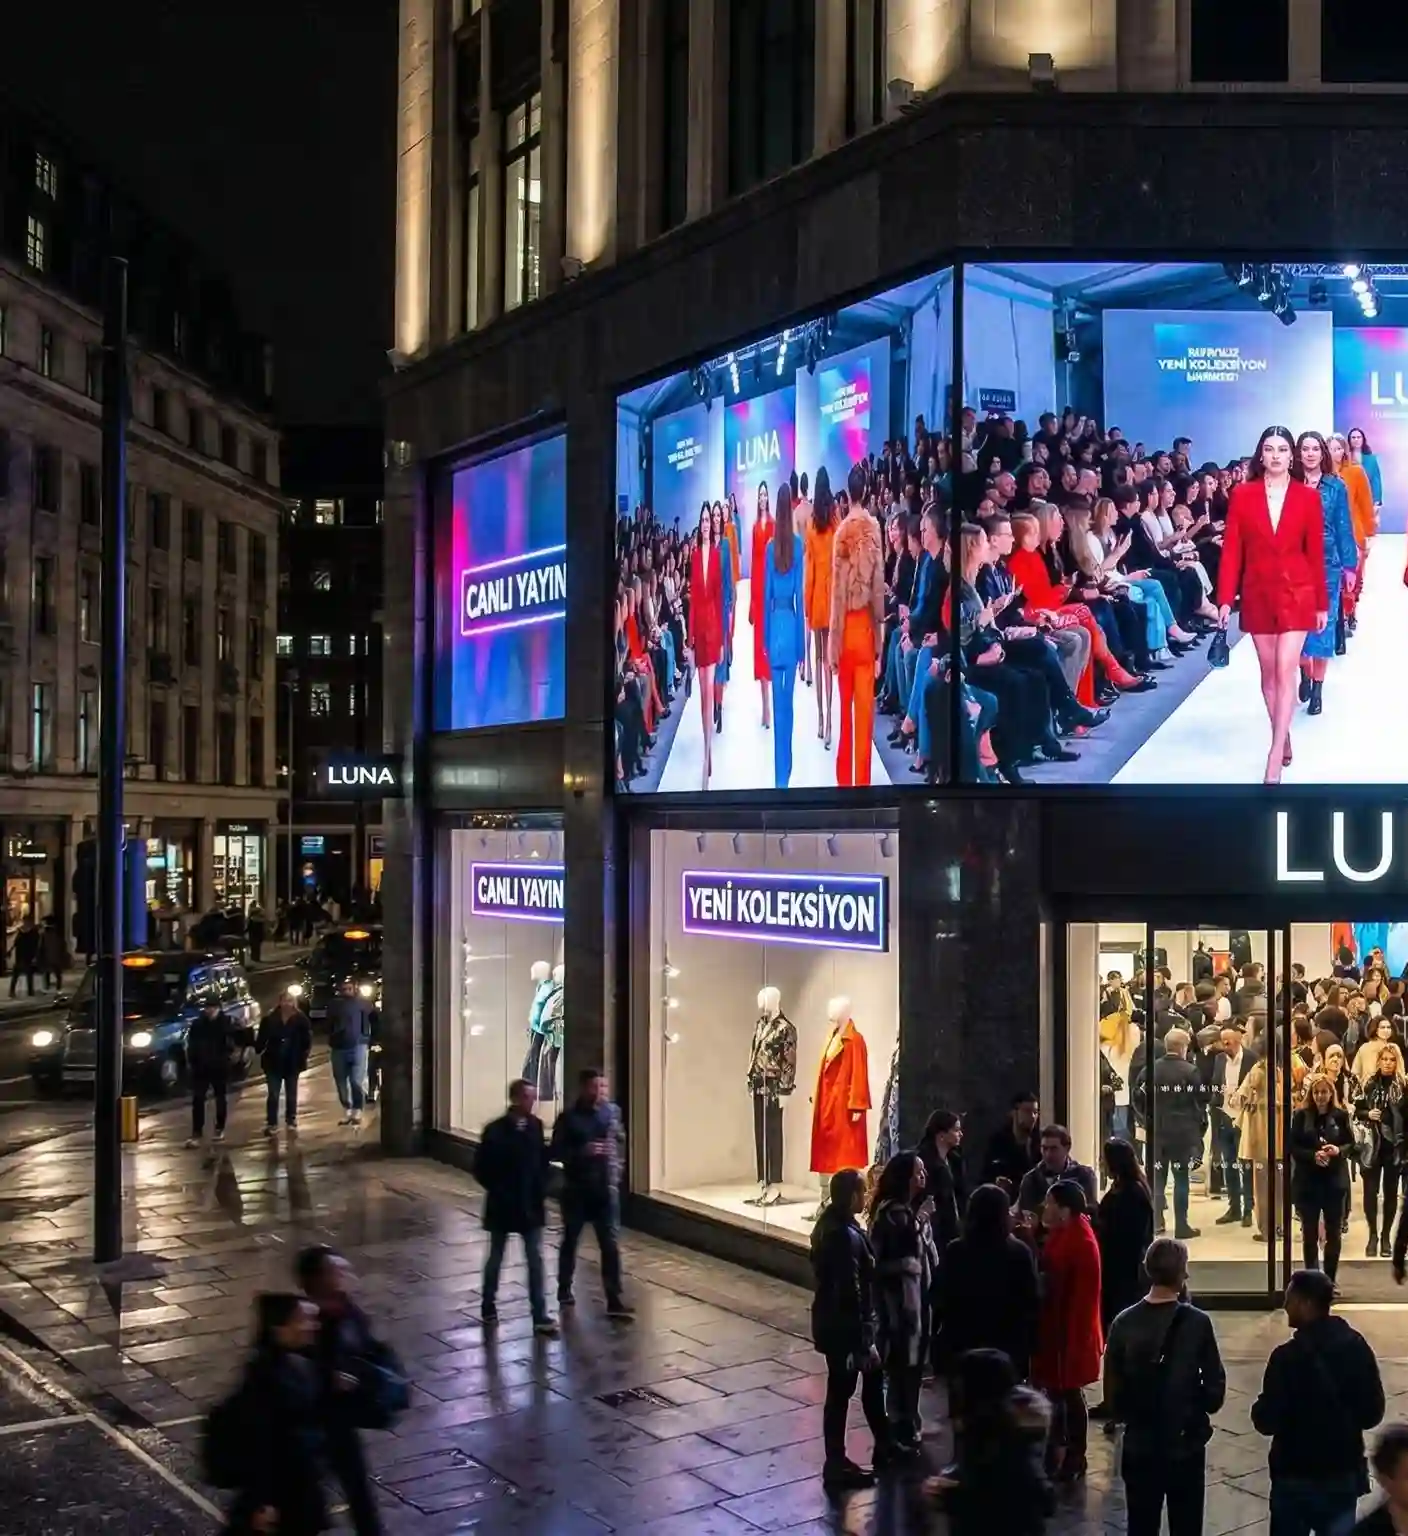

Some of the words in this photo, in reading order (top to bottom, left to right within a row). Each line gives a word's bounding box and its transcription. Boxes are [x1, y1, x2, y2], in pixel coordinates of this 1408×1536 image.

[737, 429, 781, 471] LUNA
[466, 576, 513, 619] CANLI
[515, 563, 567, 607] YAYIN
[328, 766, 395, 785] LUNA
[478, 876, 518, 906] CANLI
[520, 877, 564, 908] YAYIN
[689, 880, 733, 921] YENİ
[737, 884, 875, 932] KOLEKSİYON
